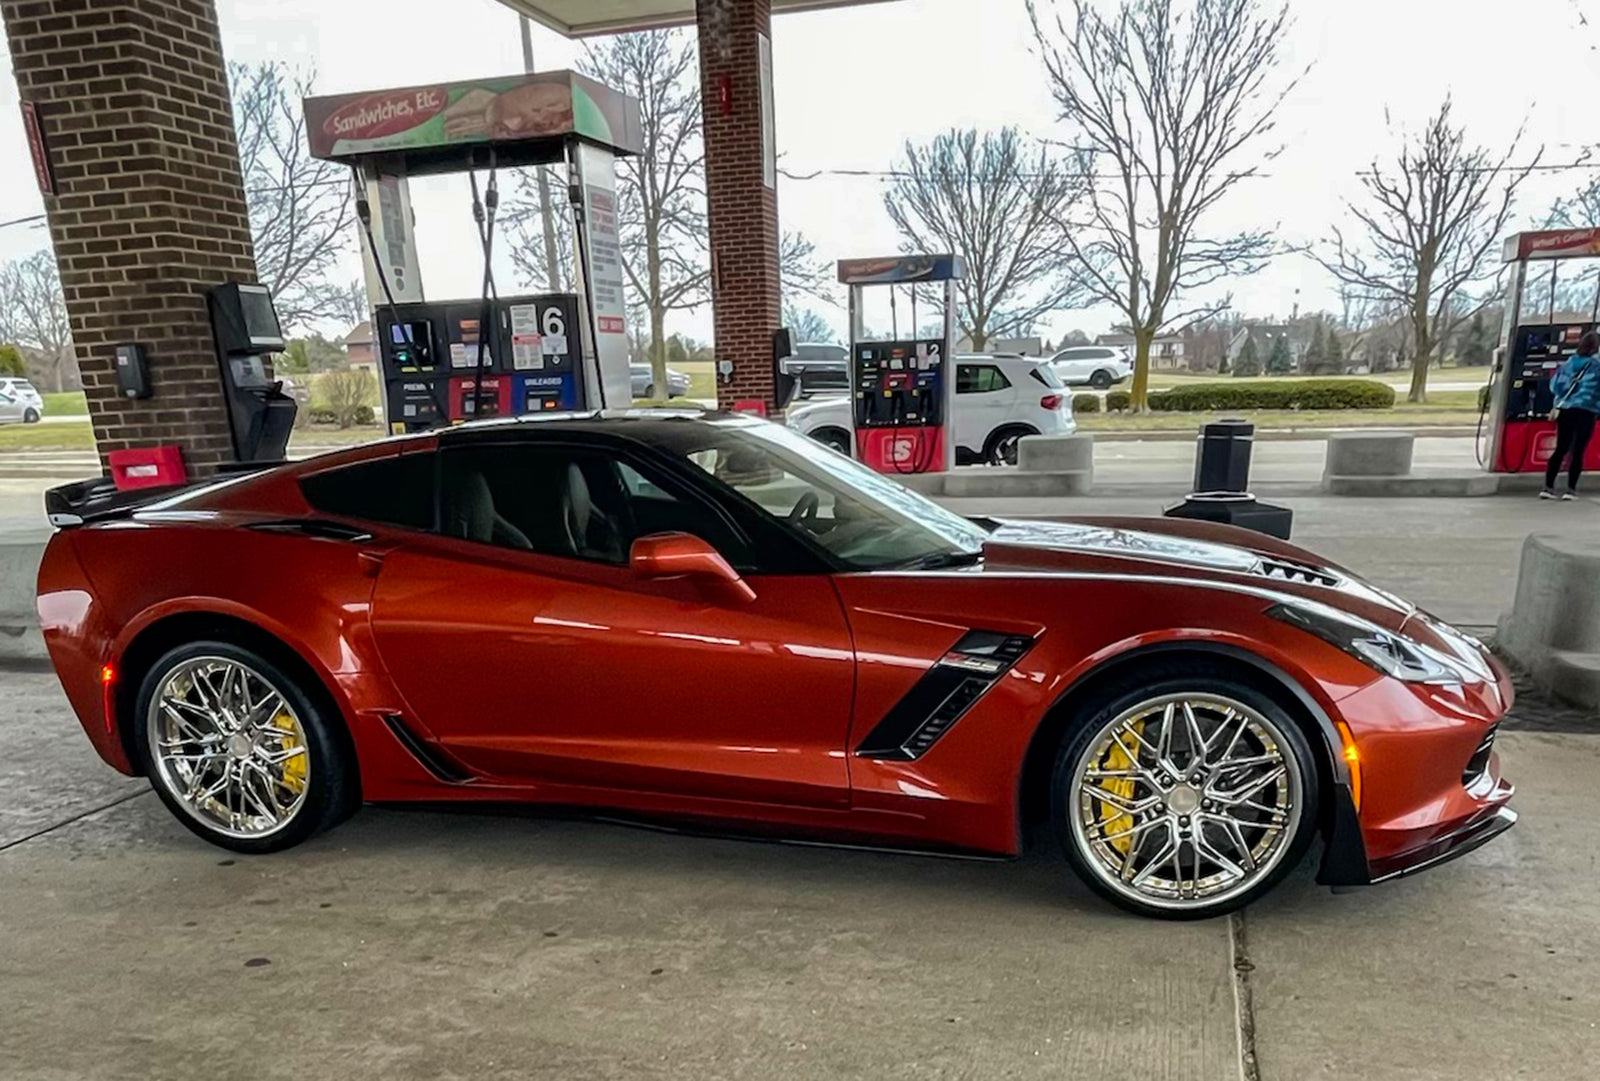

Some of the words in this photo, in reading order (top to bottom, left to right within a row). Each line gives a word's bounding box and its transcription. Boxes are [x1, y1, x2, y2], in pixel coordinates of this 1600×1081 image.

[333, 99, 414, 134] Sandwiches,
[543, 307, 564, 337] 6
[930, 344, 939, 355] 2
[889, 440, 911, 461] S
